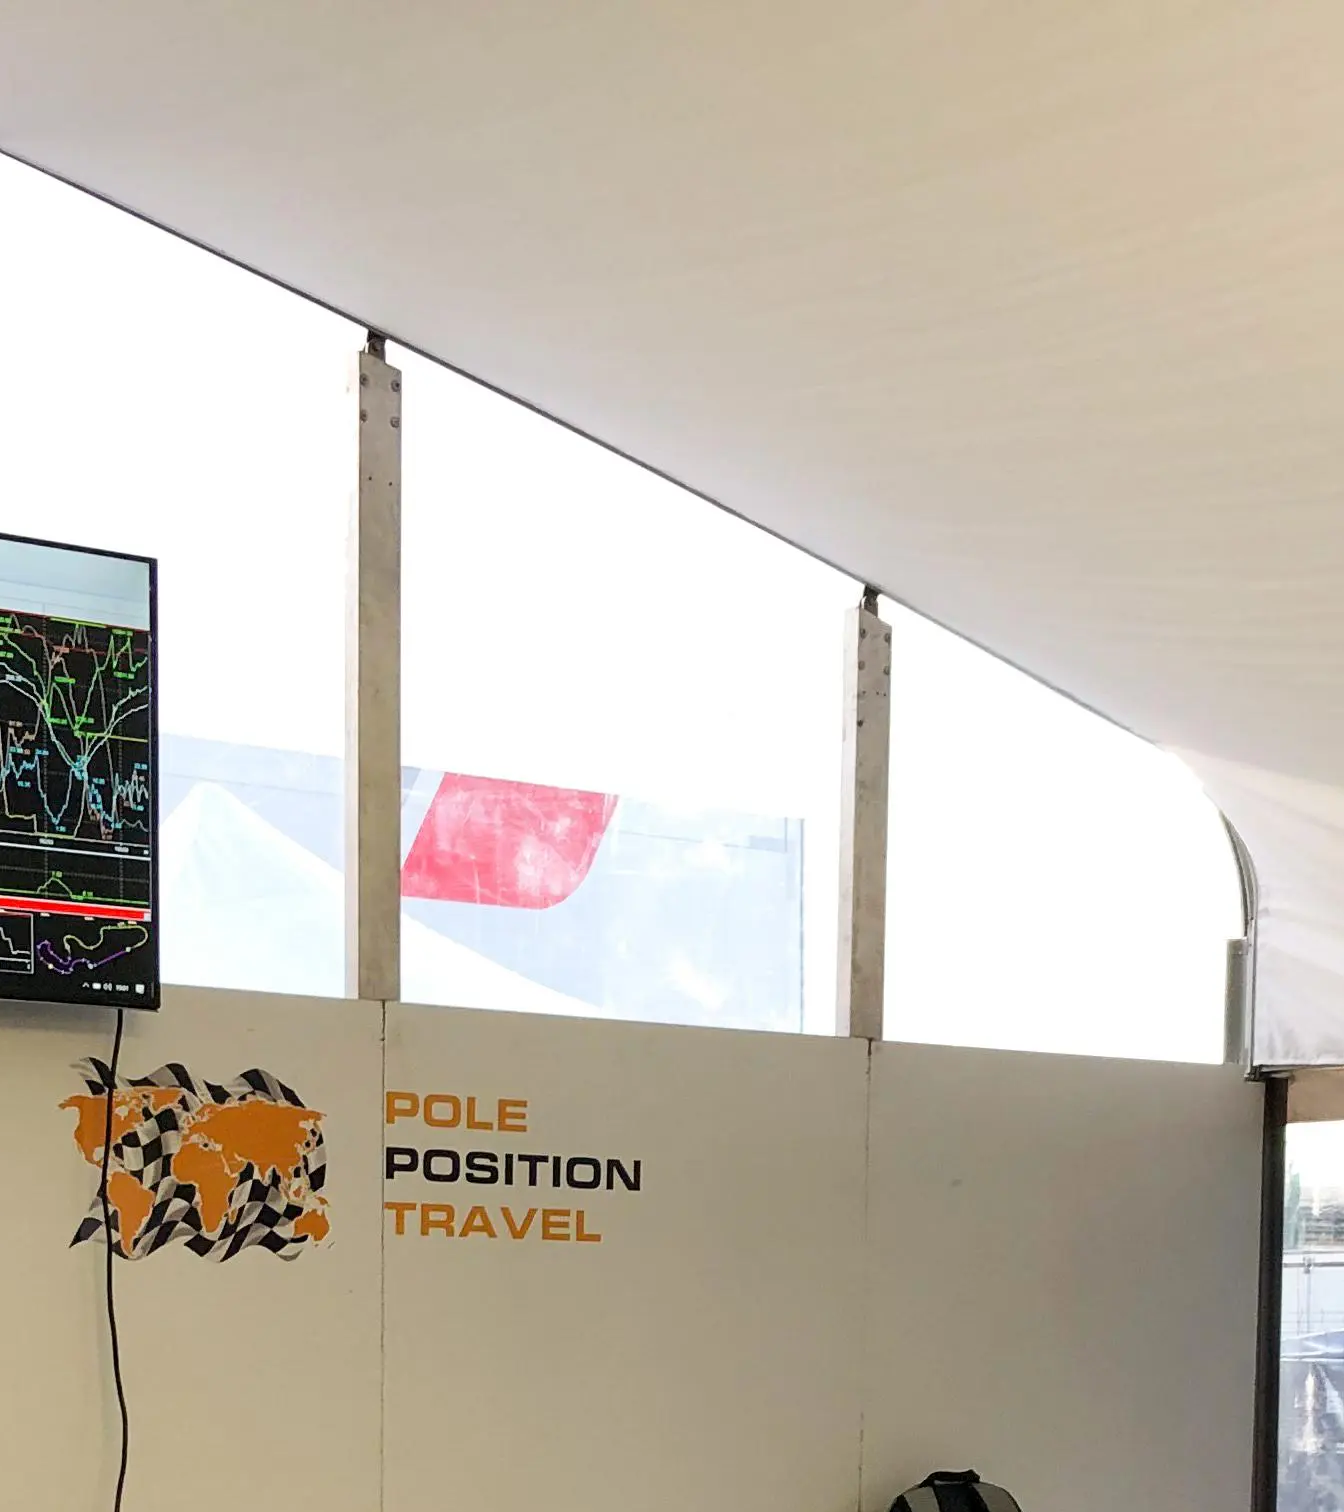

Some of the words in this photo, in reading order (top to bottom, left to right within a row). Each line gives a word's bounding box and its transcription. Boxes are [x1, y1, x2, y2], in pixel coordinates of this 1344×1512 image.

[386, 1091, 528, 1133] POLE
[385, 1146, 642, 1191] POSITION
[385, 1201, 602, 1242] TRAVEL
